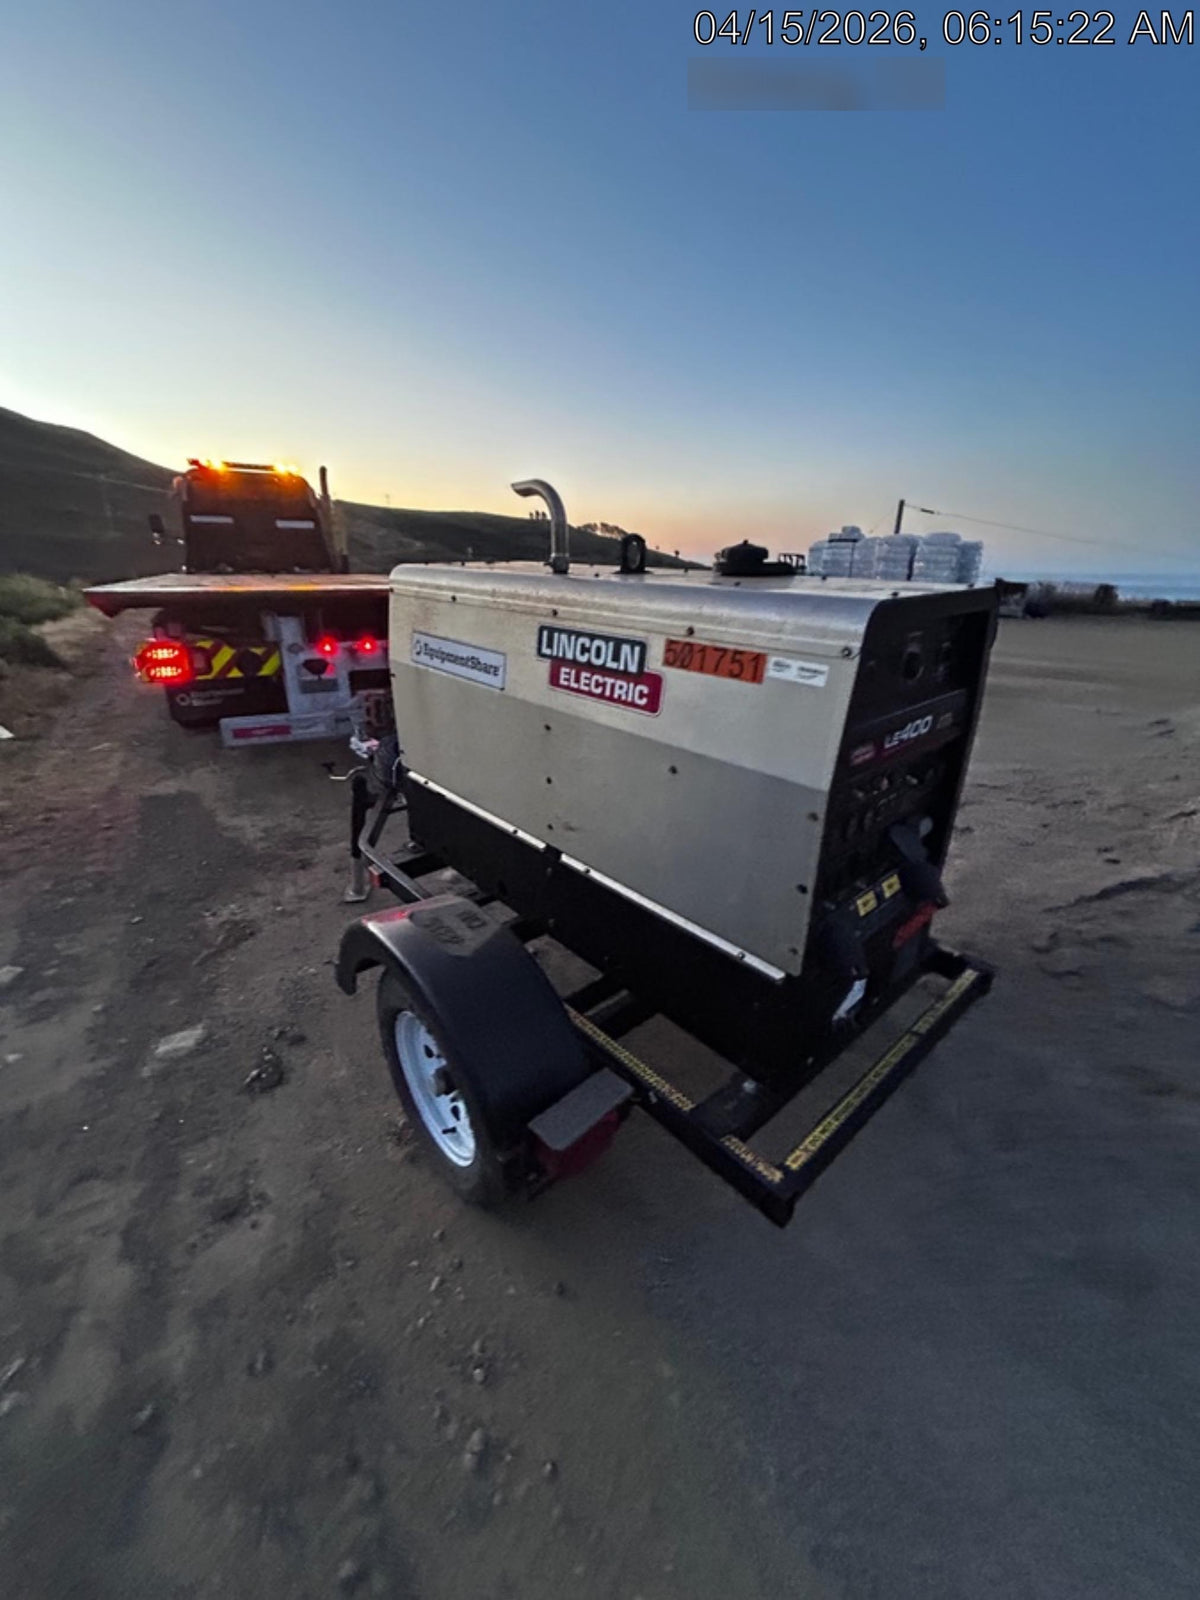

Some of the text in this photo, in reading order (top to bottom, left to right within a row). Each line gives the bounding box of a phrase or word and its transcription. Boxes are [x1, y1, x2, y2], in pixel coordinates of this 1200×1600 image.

[423, 642, 500, 677] EquipmentShare
[541, 630, 641, 673] LINCOLN
[664, 640, 762, 684] 501751
[559, 667, 649, 706] ELECTRIC
